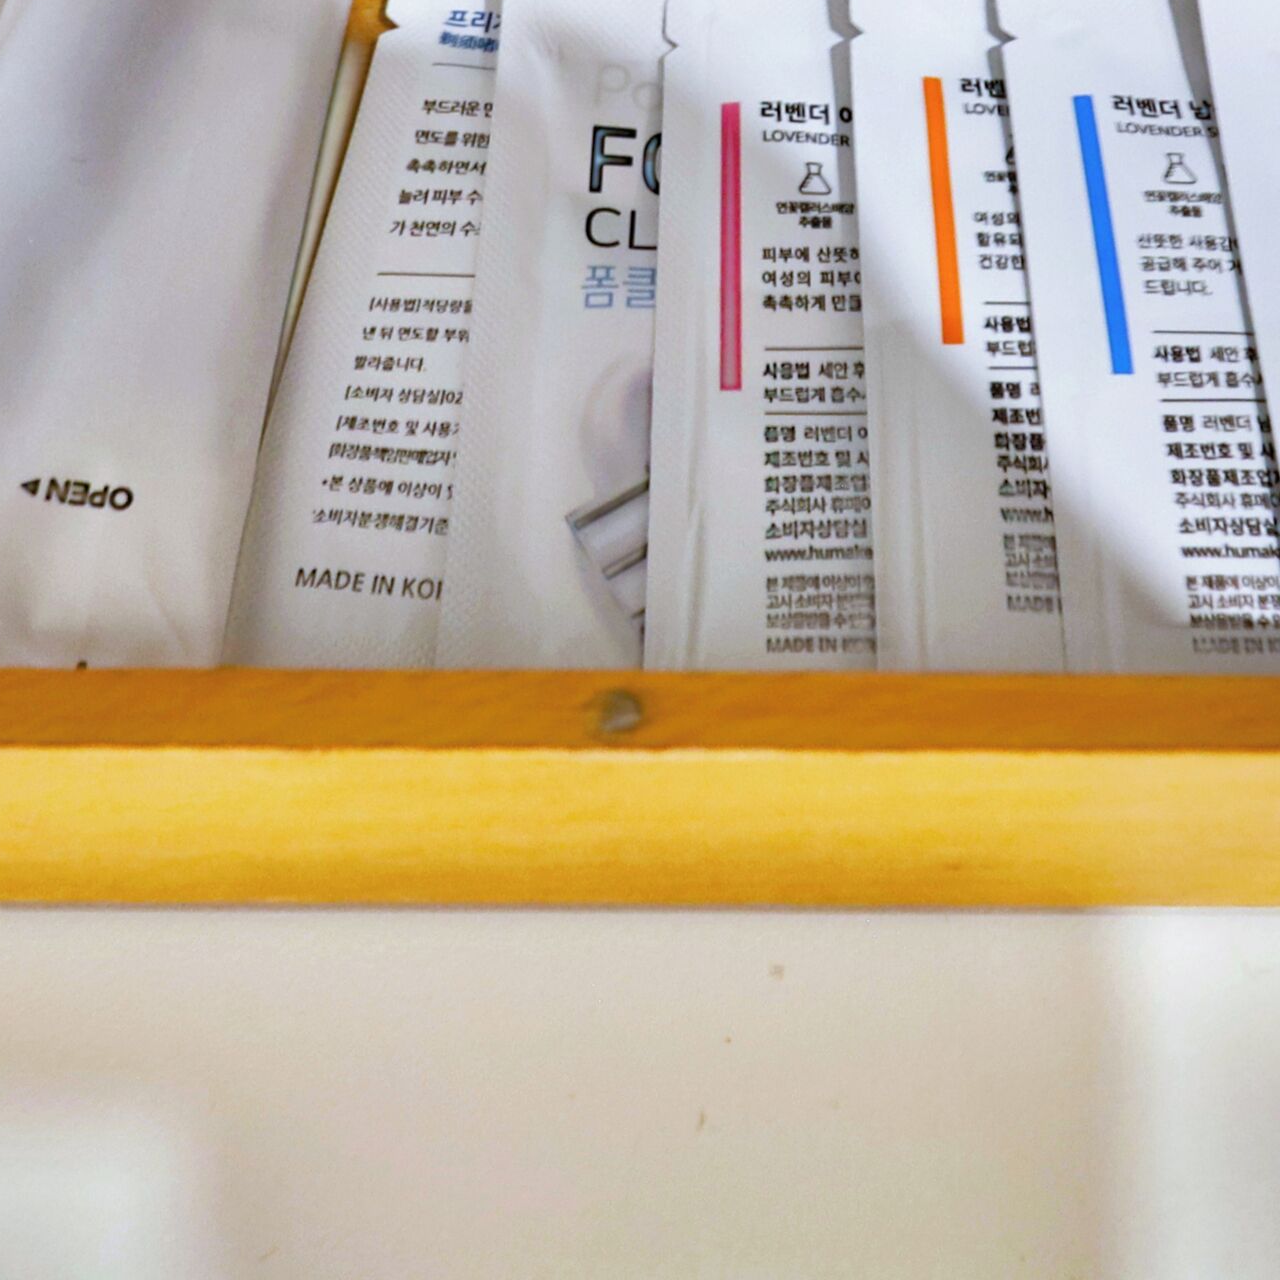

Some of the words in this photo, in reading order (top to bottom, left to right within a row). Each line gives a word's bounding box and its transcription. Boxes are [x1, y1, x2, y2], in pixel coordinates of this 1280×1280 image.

[423, 100, 480, 117] 부드러운
[760, 100, 830, 126] 러벤더
[1111, 95, 1182, 120] 러벤더
[415, 130, 458, 146] 면도를
[763, 129, 851, 147] LOVENDER
[1115, 122, 1202, 138] LOVENDER
[407, 158, 487, 176] 촉촉하면서
[432, 189, 462, 205] 피부
[974, 211, 1020, 227] 여성의
[460, 220, 482, 237] 수
[584, 207, 658, 250] CL
[1138, 234, 1183, 249] 산뜻한
[762, 247, 810, 263] 피부에
[1192, 258, 1222, 273] 주어
[762, 271, 811, 288] 여성의
[1144, 279, 1213, 296] 드립니다.
[762, 295, 826, 312] 촉촉하게
[985, 317, 1032, 333] 사용법
[1154, 345, 1202, 362] 사용법
[1210, 346, 1240, 362] 세안
[763, 362, 810, 379] 사용법
[818, 363, 849, 379] 세안
[1157, 372, 1220, 388] 부드럽게
[764, 387, 826, 403] 부드럽게
[990, 382, 1022, 399] 품명
[1163, 414, 1196, 432] 품명
[1202, 414, 1252, 432] 러벤더
[765, 426, 796, 442] 품명
[764, 450, 830, 468] 제조번호
[835, 450, 851, 468] 및
[1166, 442, 1234, 460] 제조번호
[45, 477, 134, 511] OPEN
[1175, 491, 1236, 510] 주식회사
[766, 497, 826, 517] 주식회사
[765, 519, 868, 540] 소비자상담실
[1179, 516, 1279, 537] 소비자상담실
[295, 568, 365, 592] MADE
[371, 575, 395, 596] IN
[1188, 594, 1214, 610] 고시
[1218, 594, 1255, 610] 소비자
[767, 637, 813, 653] MADE
[818, 637, 837, 653] IN
